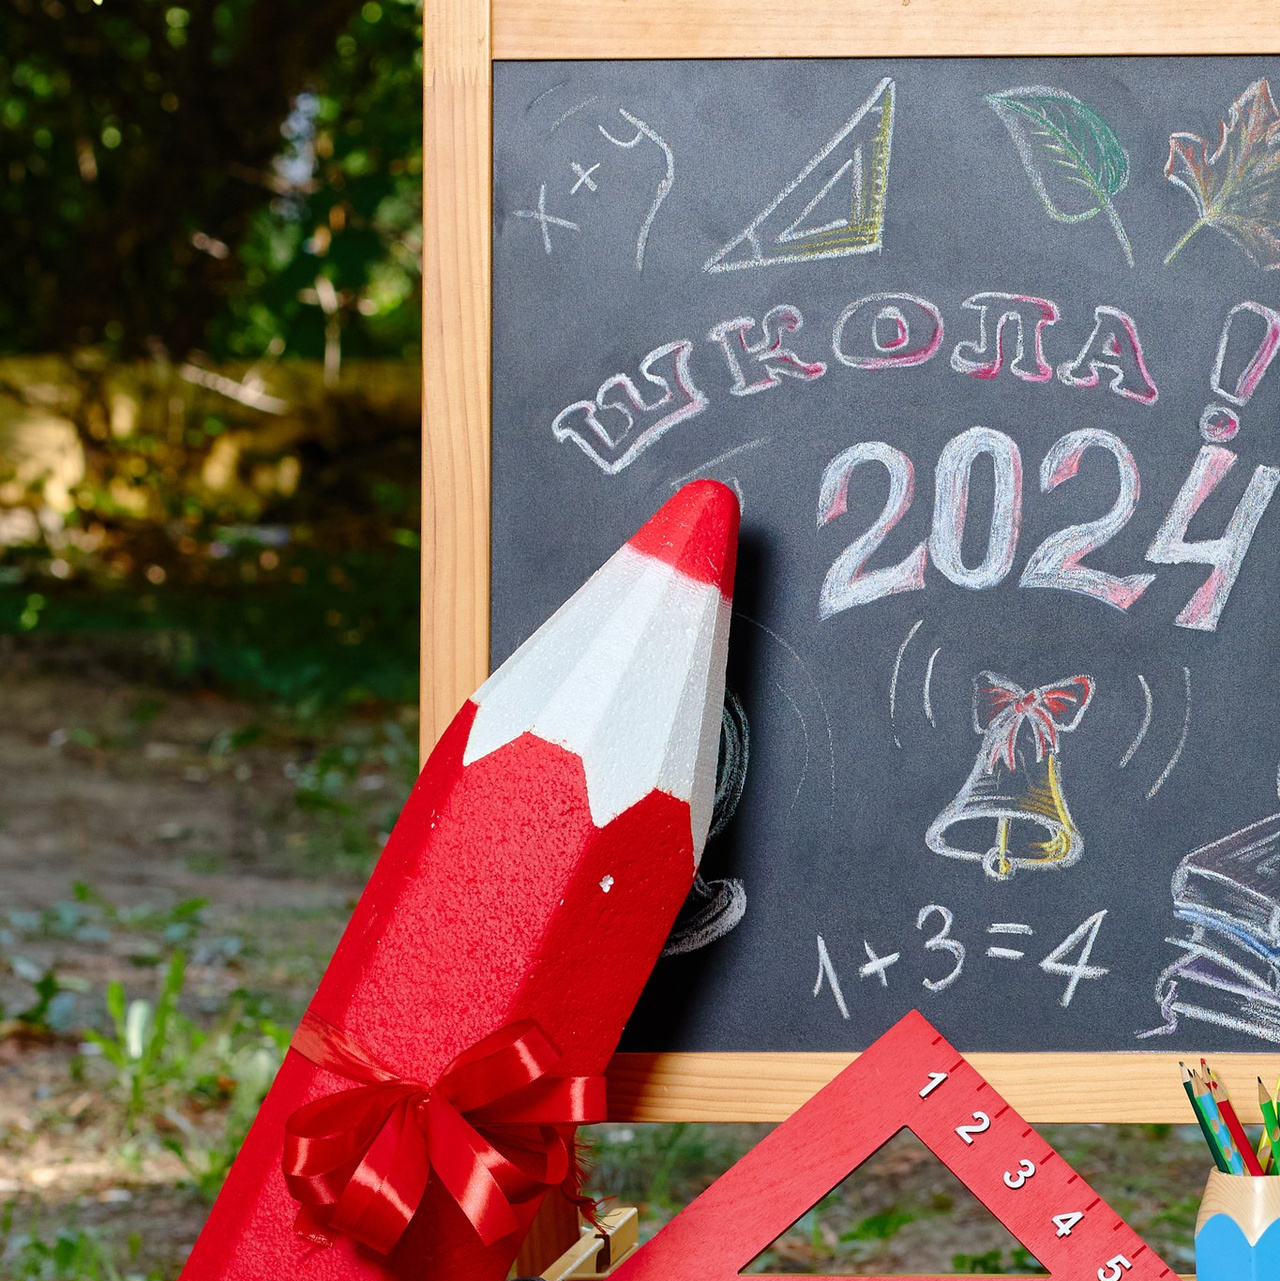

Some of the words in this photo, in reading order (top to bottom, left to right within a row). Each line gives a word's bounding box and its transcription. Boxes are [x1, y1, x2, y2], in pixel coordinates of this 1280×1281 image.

[917, 1071, 948, 1100] 1
[954, 1110, 991, 1145] 2
[1002, 1158, 1036, 1190] 3
[1050, 1209, 1085, 1238] 4
